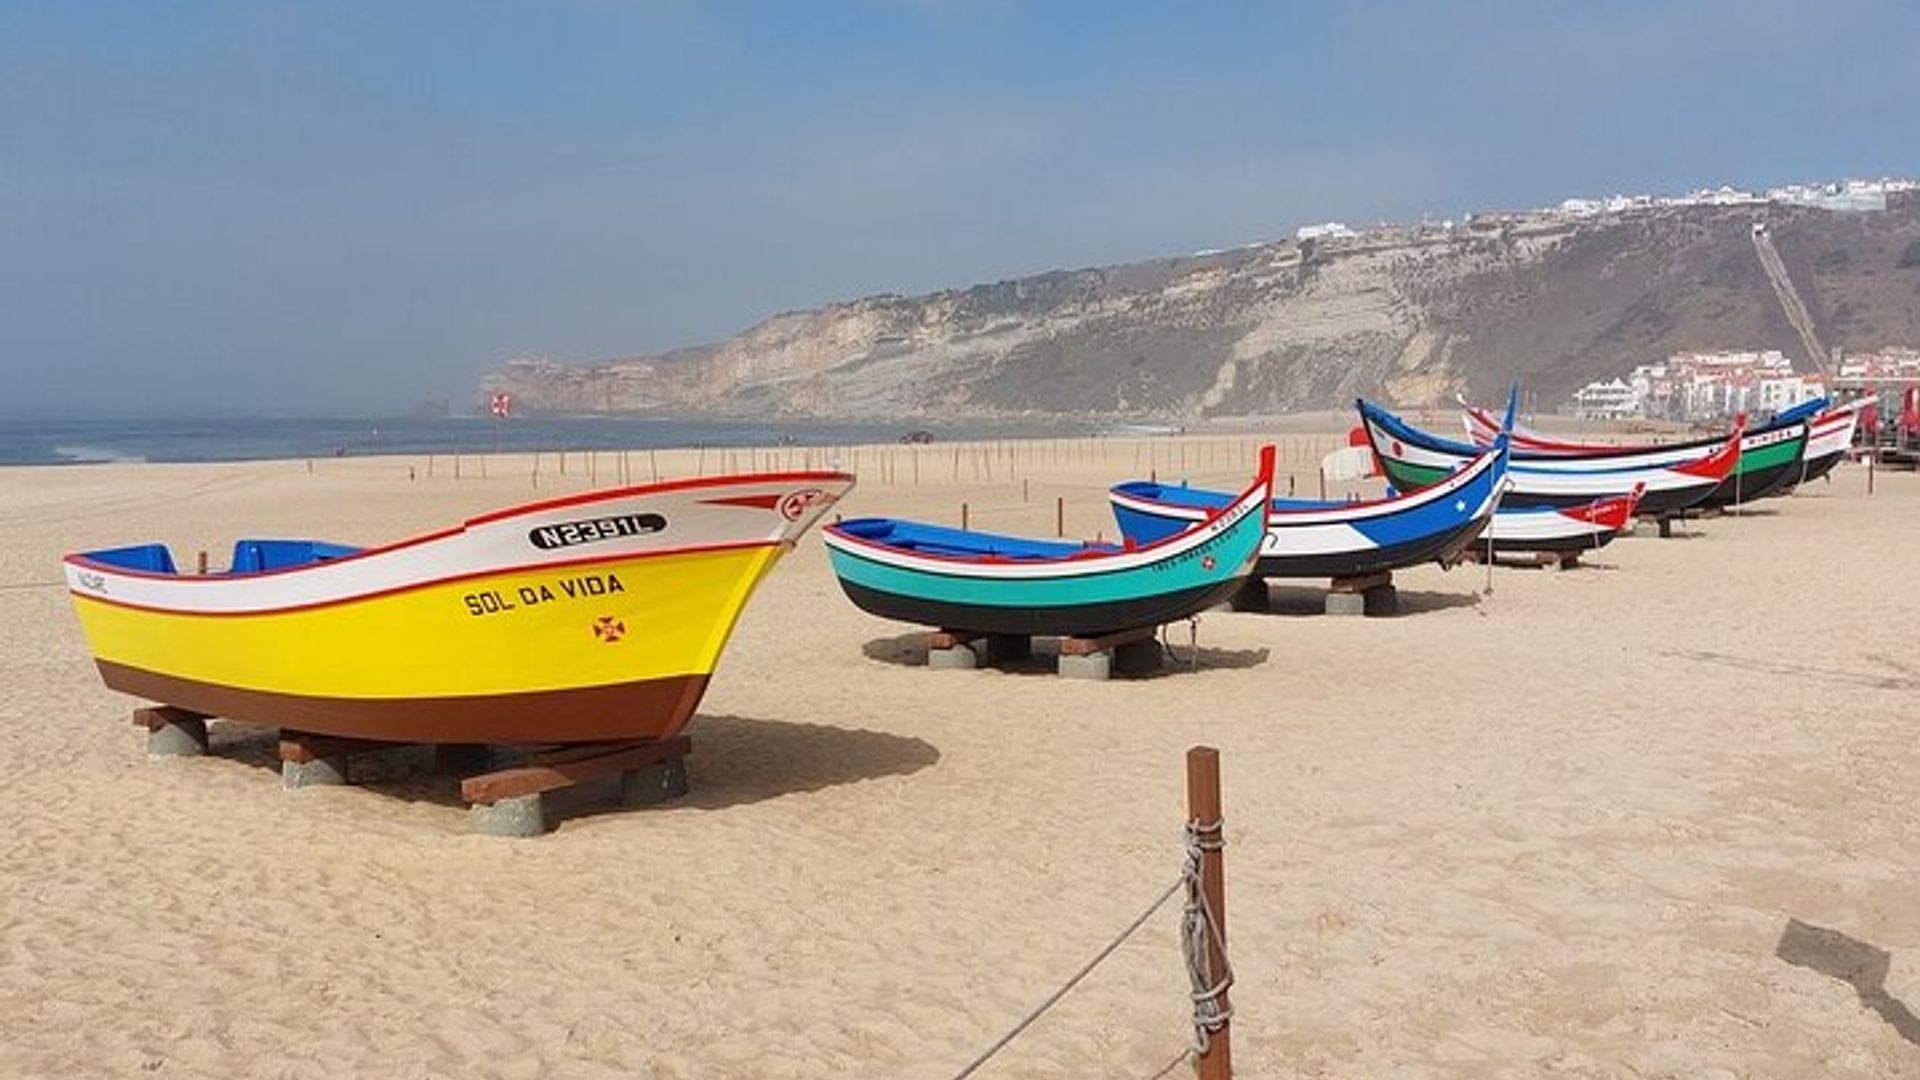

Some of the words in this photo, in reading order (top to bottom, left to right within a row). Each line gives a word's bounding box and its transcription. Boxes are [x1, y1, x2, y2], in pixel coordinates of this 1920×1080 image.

[541, 517, 653, 547] N2391L
[464, 591, 515, 616] SOL
[519, 586, 556, 605] DA
[559, 573, 625, 599] VIDA
